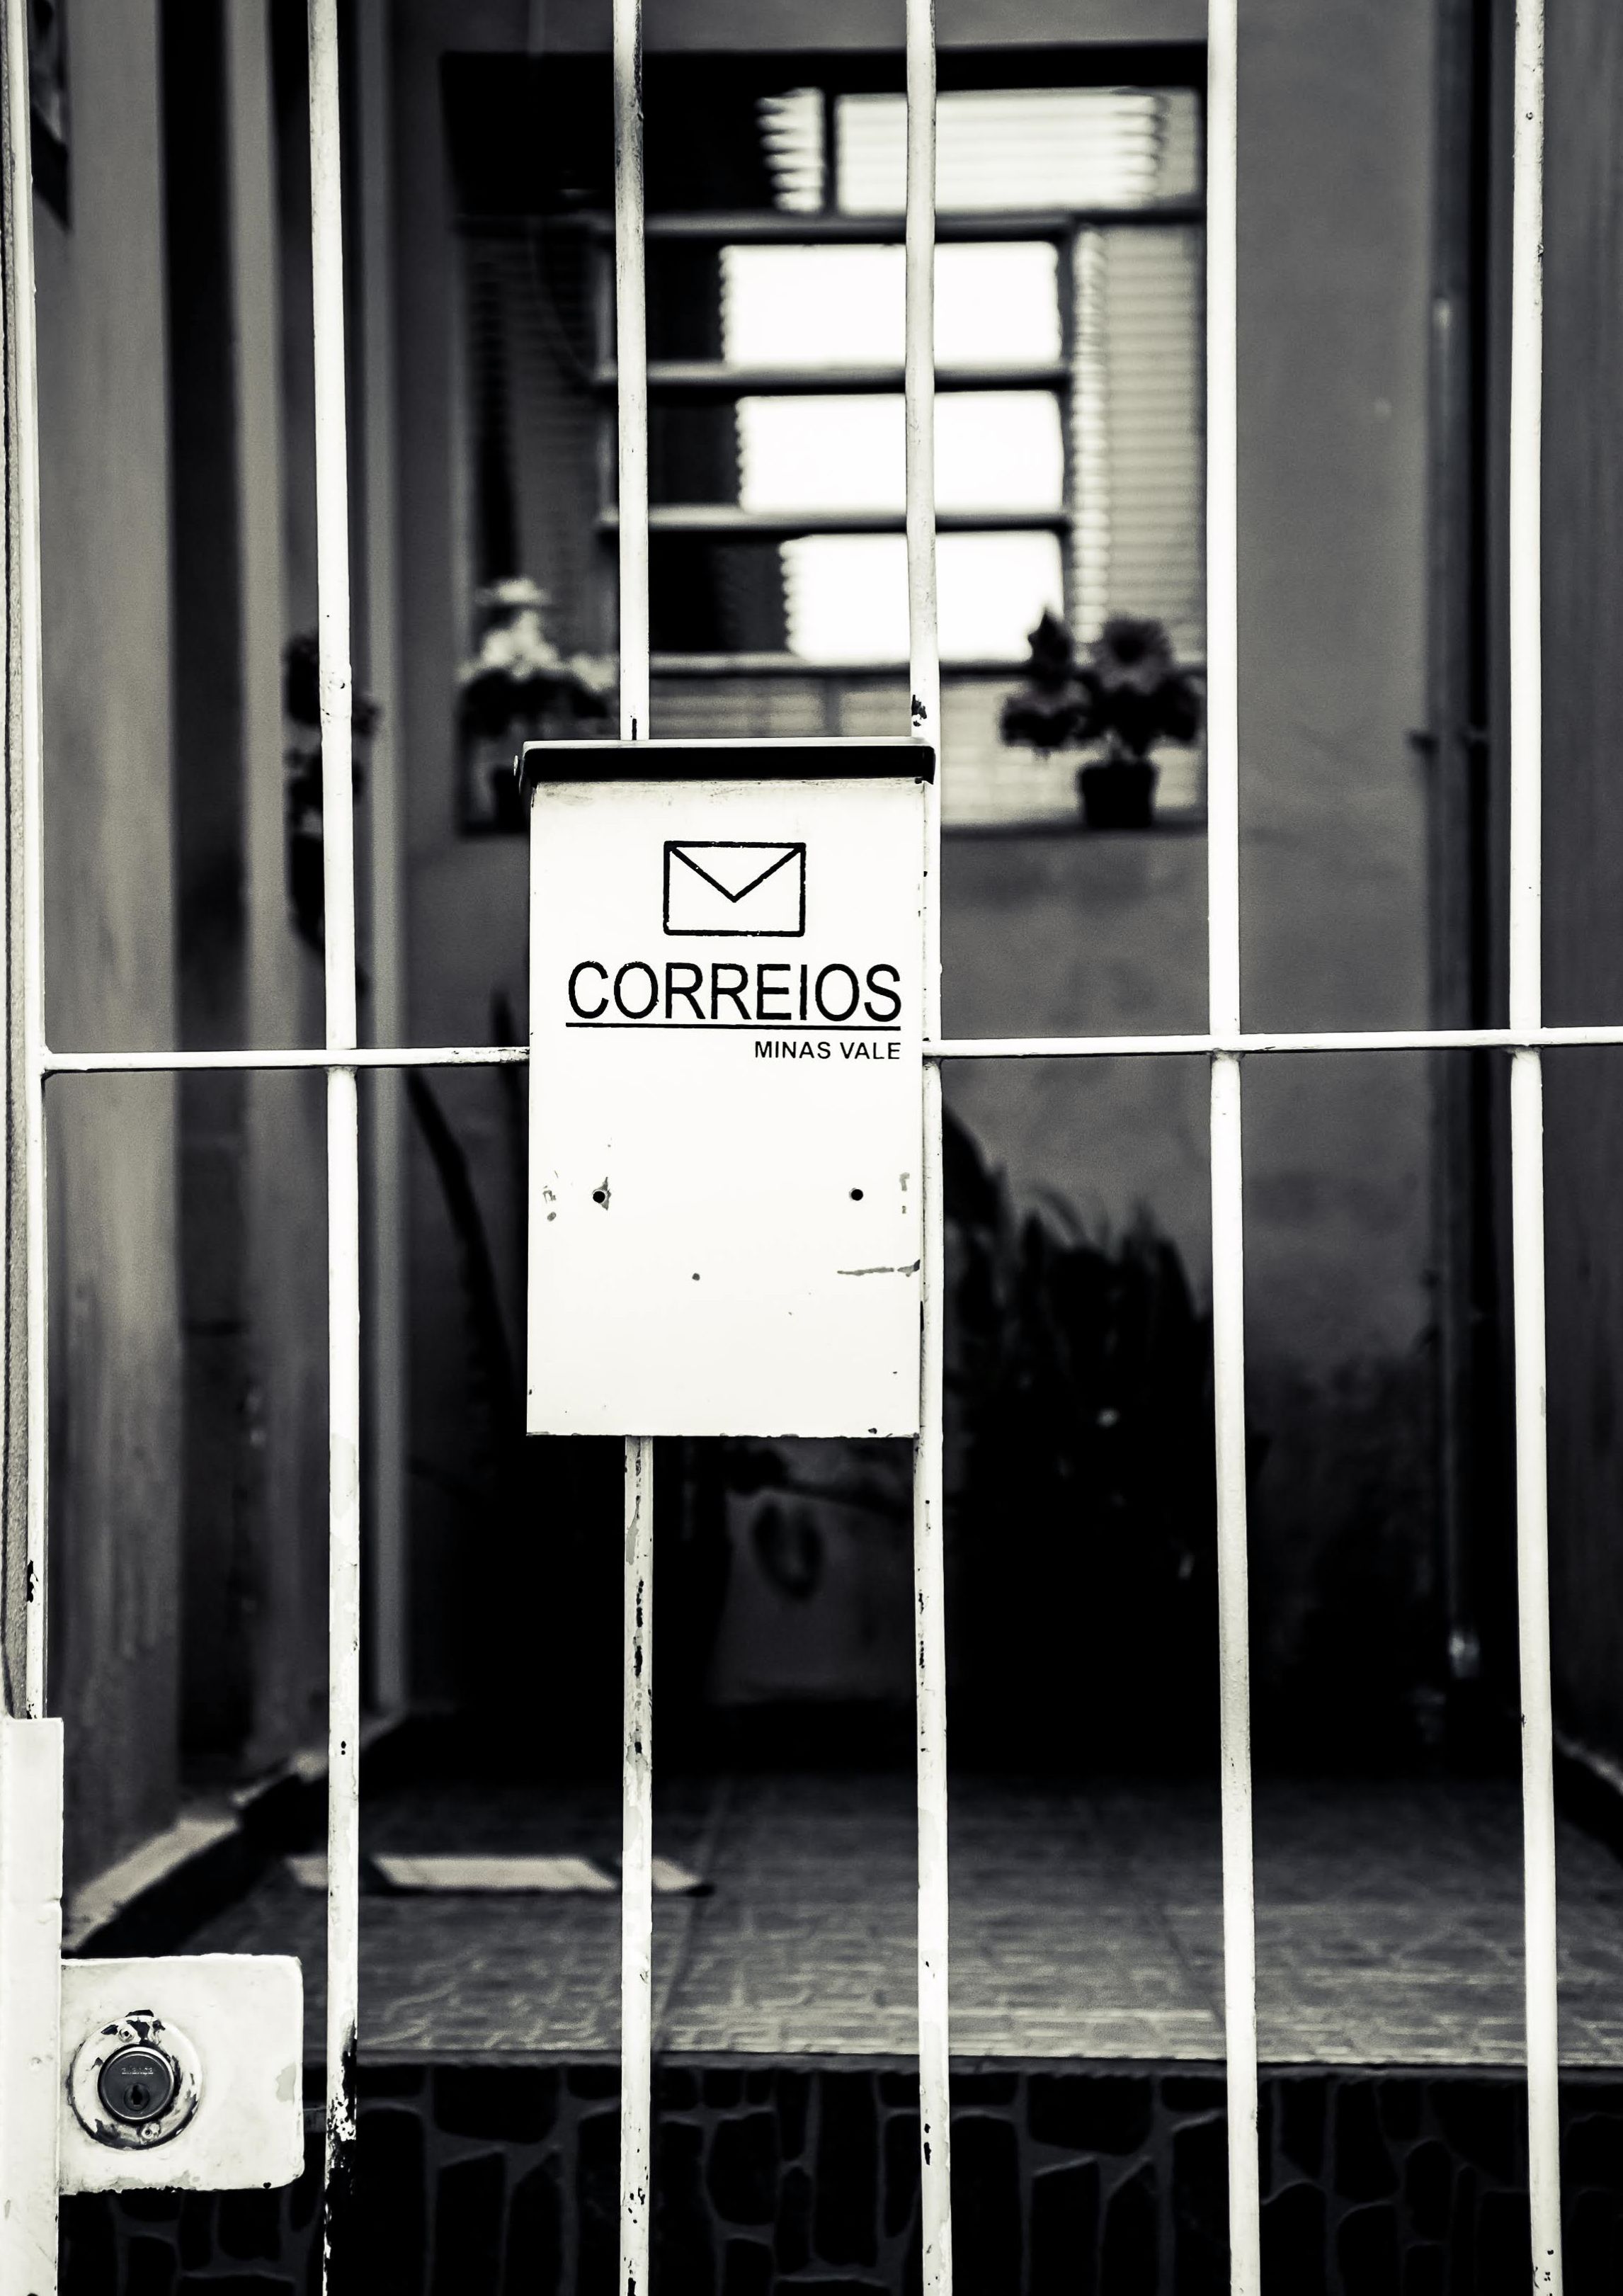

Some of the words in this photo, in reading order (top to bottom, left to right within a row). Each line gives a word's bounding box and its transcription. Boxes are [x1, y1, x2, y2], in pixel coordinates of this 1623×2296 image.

[568, 960, 902, 1022] CORREIOS
[755, 1040, 831, 1059] MINAS
[839, 1042, 901, 1059] VALE
